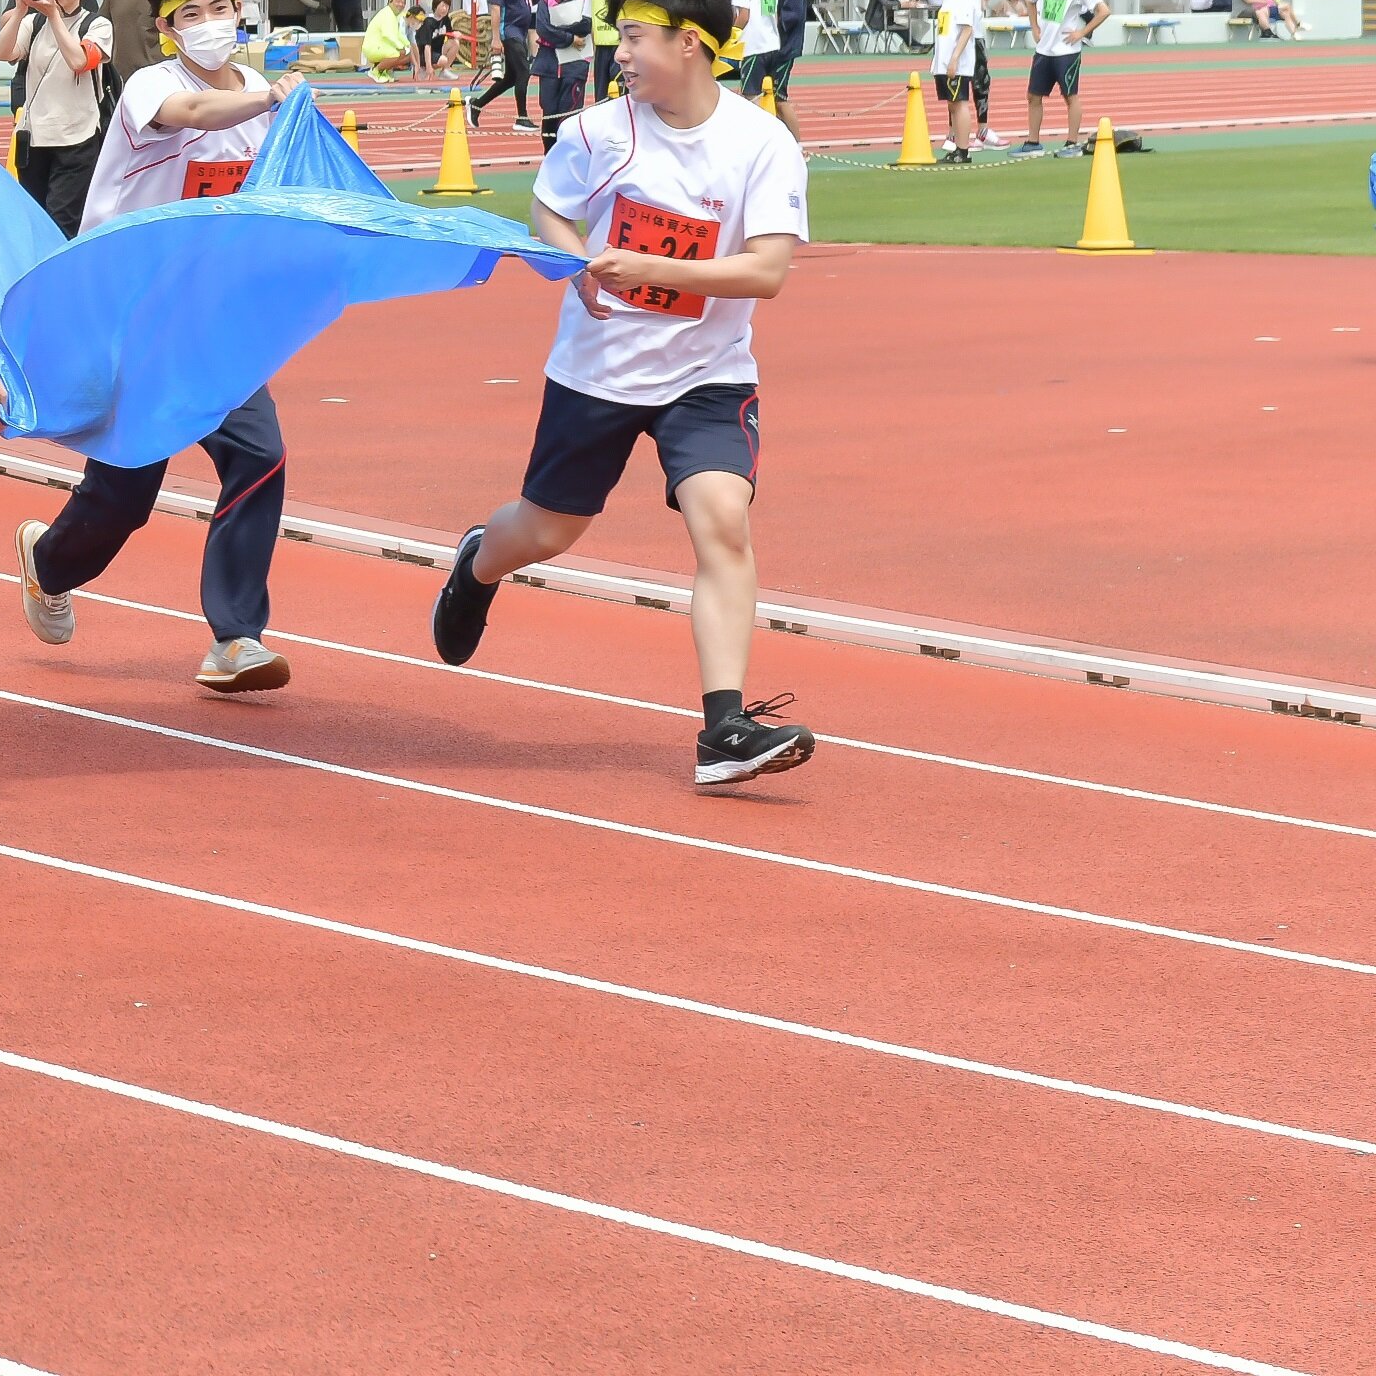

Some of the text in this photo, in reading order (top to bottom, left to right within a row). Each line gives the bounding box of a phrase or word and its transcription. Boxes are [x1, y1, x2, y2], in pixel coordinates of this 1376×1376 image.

[197, 165, 251, 177] SDH体育
[618, 202, 709, 238] SDH体育大会
